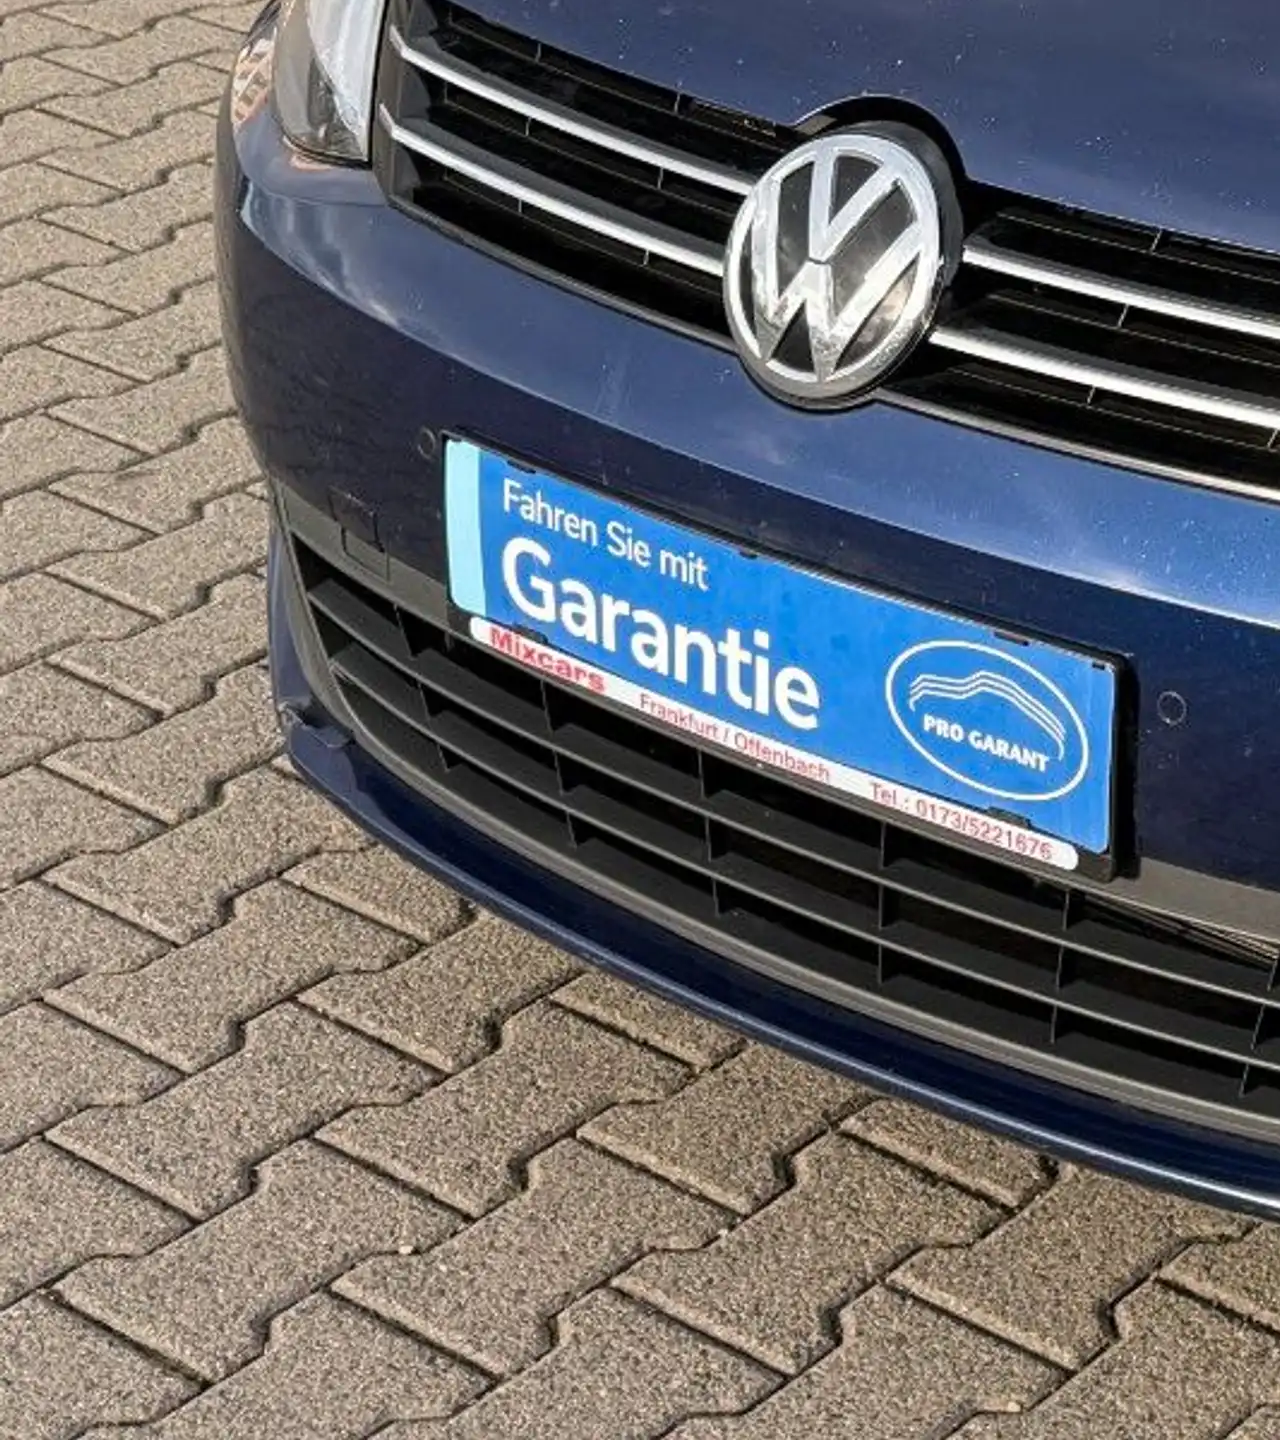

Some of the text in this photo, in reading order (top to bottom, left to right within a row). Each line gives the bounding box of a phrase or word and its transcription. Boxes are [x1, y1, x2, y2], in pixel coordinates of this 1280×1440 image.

[724, 133, 940, 398] VW
[502, 477, 710, 592] Fahren Sie mit
[502, 536, 821, 731] Garantie
[489, 626, 608, 695] Mixcars
[639, 692, 721, 741] Frankfurt
[733, 732, 833, 784] Offenbach
[915, 797, 1054, 862] 0173/5221676
[923, 713, 1050, 773] PRO GARANT
